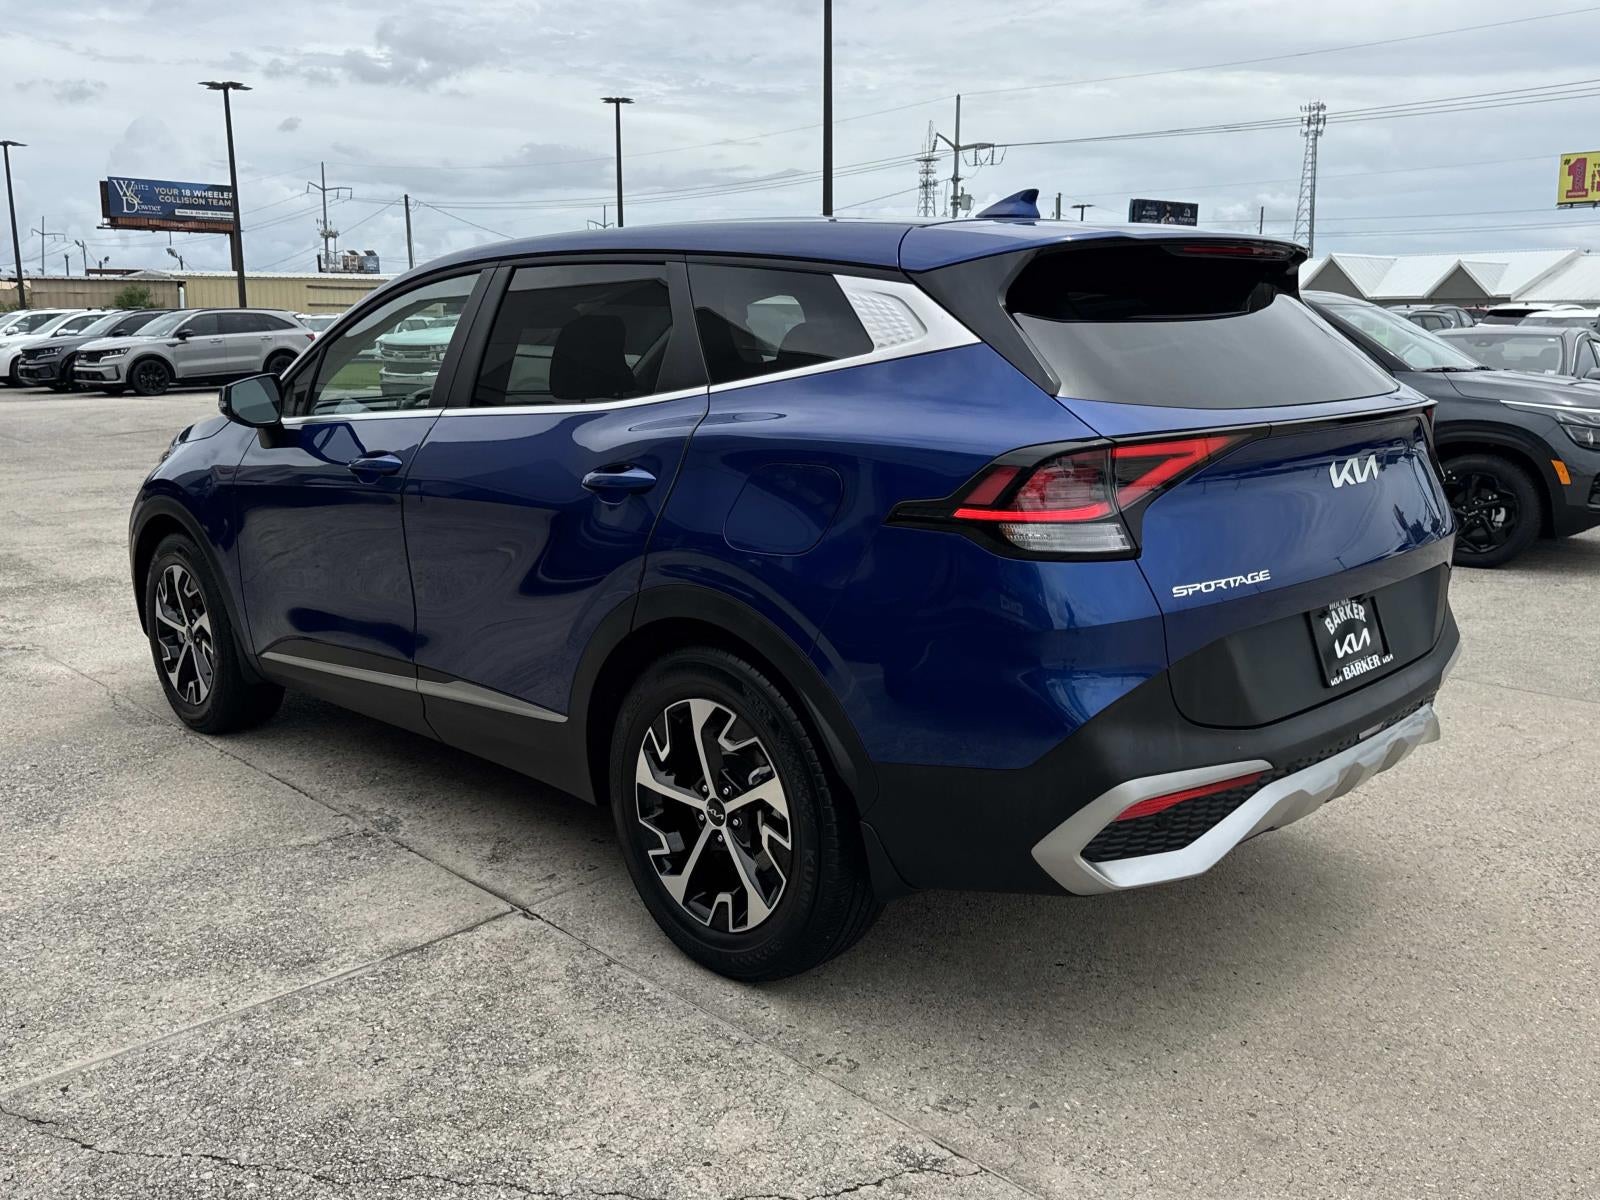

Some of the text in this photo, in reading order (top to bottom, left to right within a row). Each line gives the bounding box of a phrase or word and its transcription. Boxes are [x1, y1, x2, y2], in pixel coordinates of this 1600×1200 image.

[153, 186, 179, 196] YOUR
[181, 188, 191, 197] 18
[159, 195, 232, 207] COLLISION TEAM
[1172, 569, 1271, 598] SPORTAGE
[1325, 602, 1367, 636] BARKER
[1342, 654, 1382, 680] BARKER
